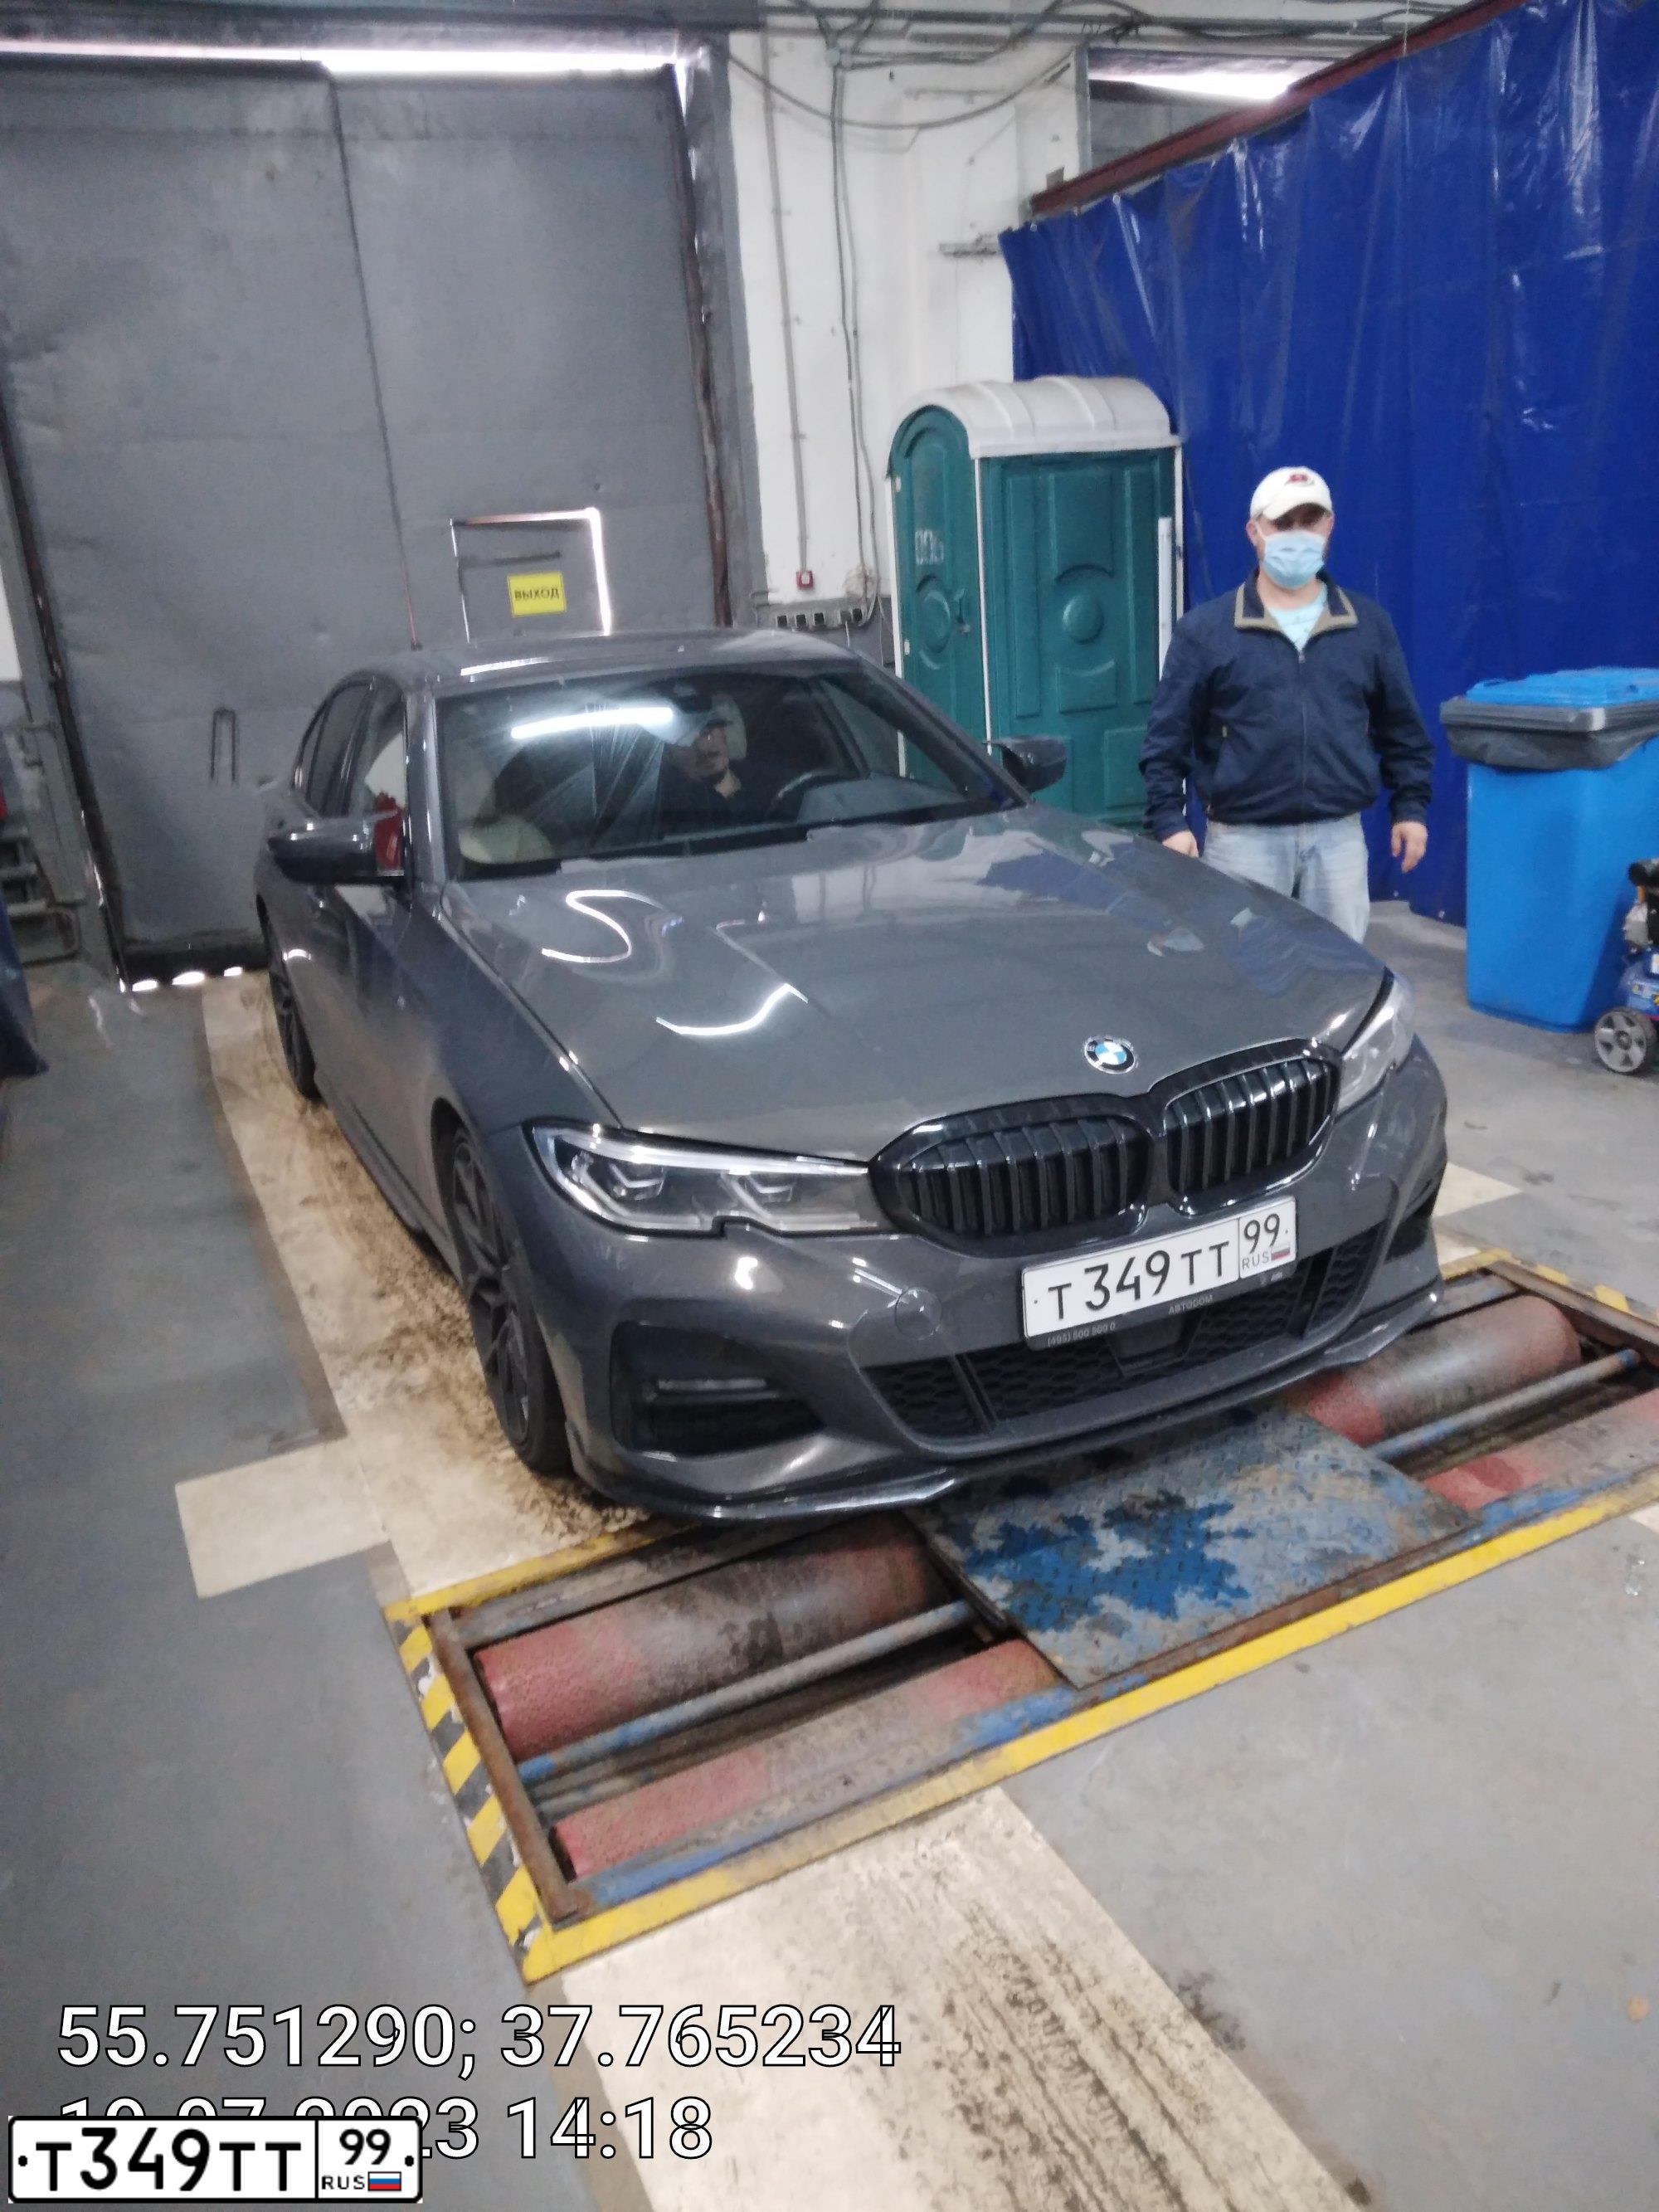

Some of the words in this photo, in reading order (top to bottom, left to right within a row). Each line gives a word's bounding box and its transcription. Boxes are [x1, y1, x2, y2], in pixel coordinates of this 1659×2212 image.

[514, 587, 560, 601] ВЫХОД
[1244, 1213, 1280, 1254] 99
[1242, 1251, 1269, 1270] RUS
[1048, 1240, 1229, 1321] Т349ТТ
